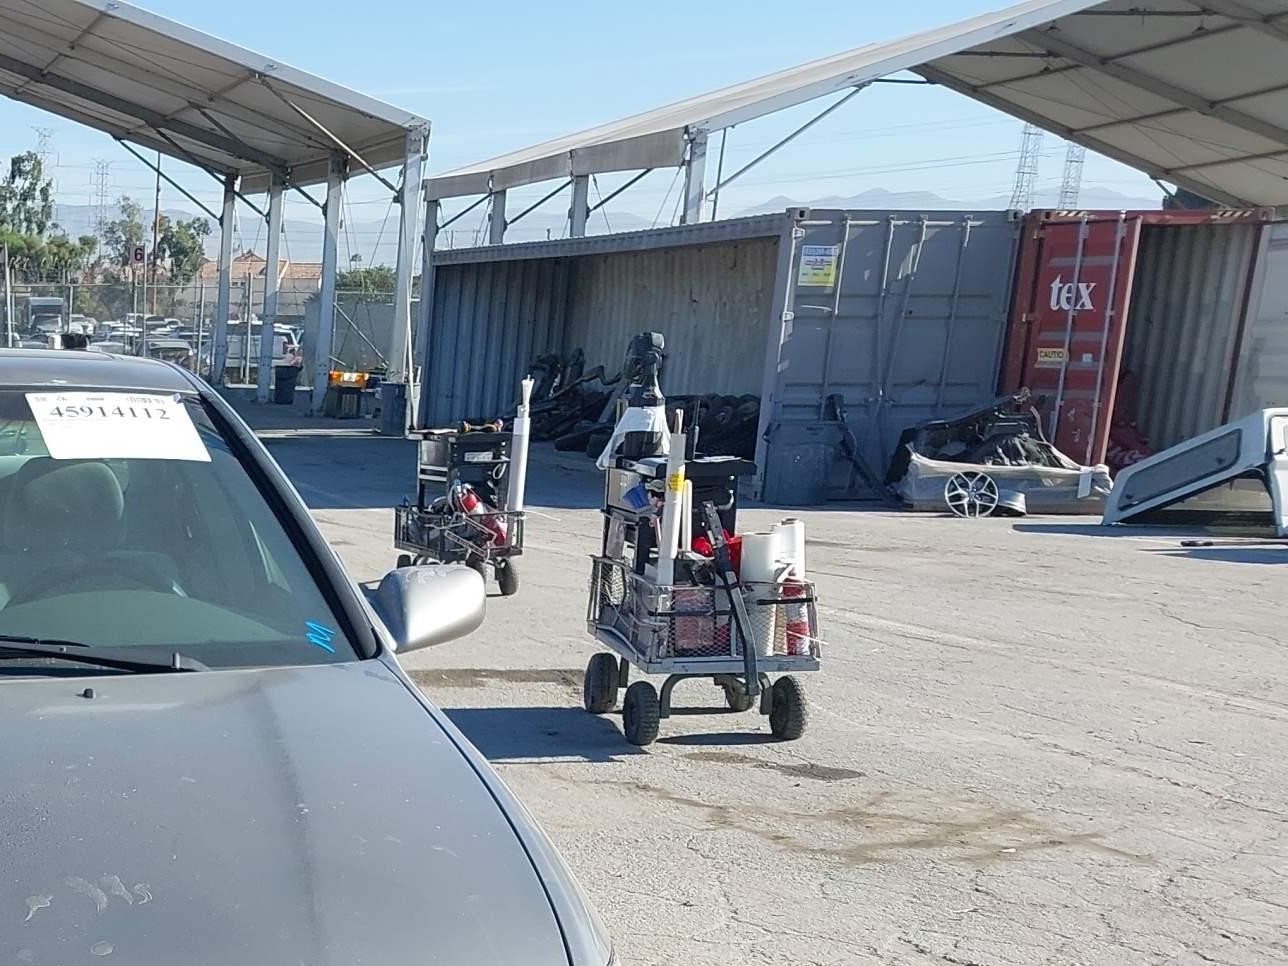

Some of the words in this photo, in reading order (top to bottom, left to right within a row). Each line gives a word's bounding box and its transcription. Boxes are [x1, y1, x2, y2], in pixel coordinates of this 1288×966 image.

[134, 247, 144, 261] 6
[1050, 273, 1096, 311] tex
[1039, 350, 1066, 359] CAUTIO
[49, 405, 170, 420] 45914112
